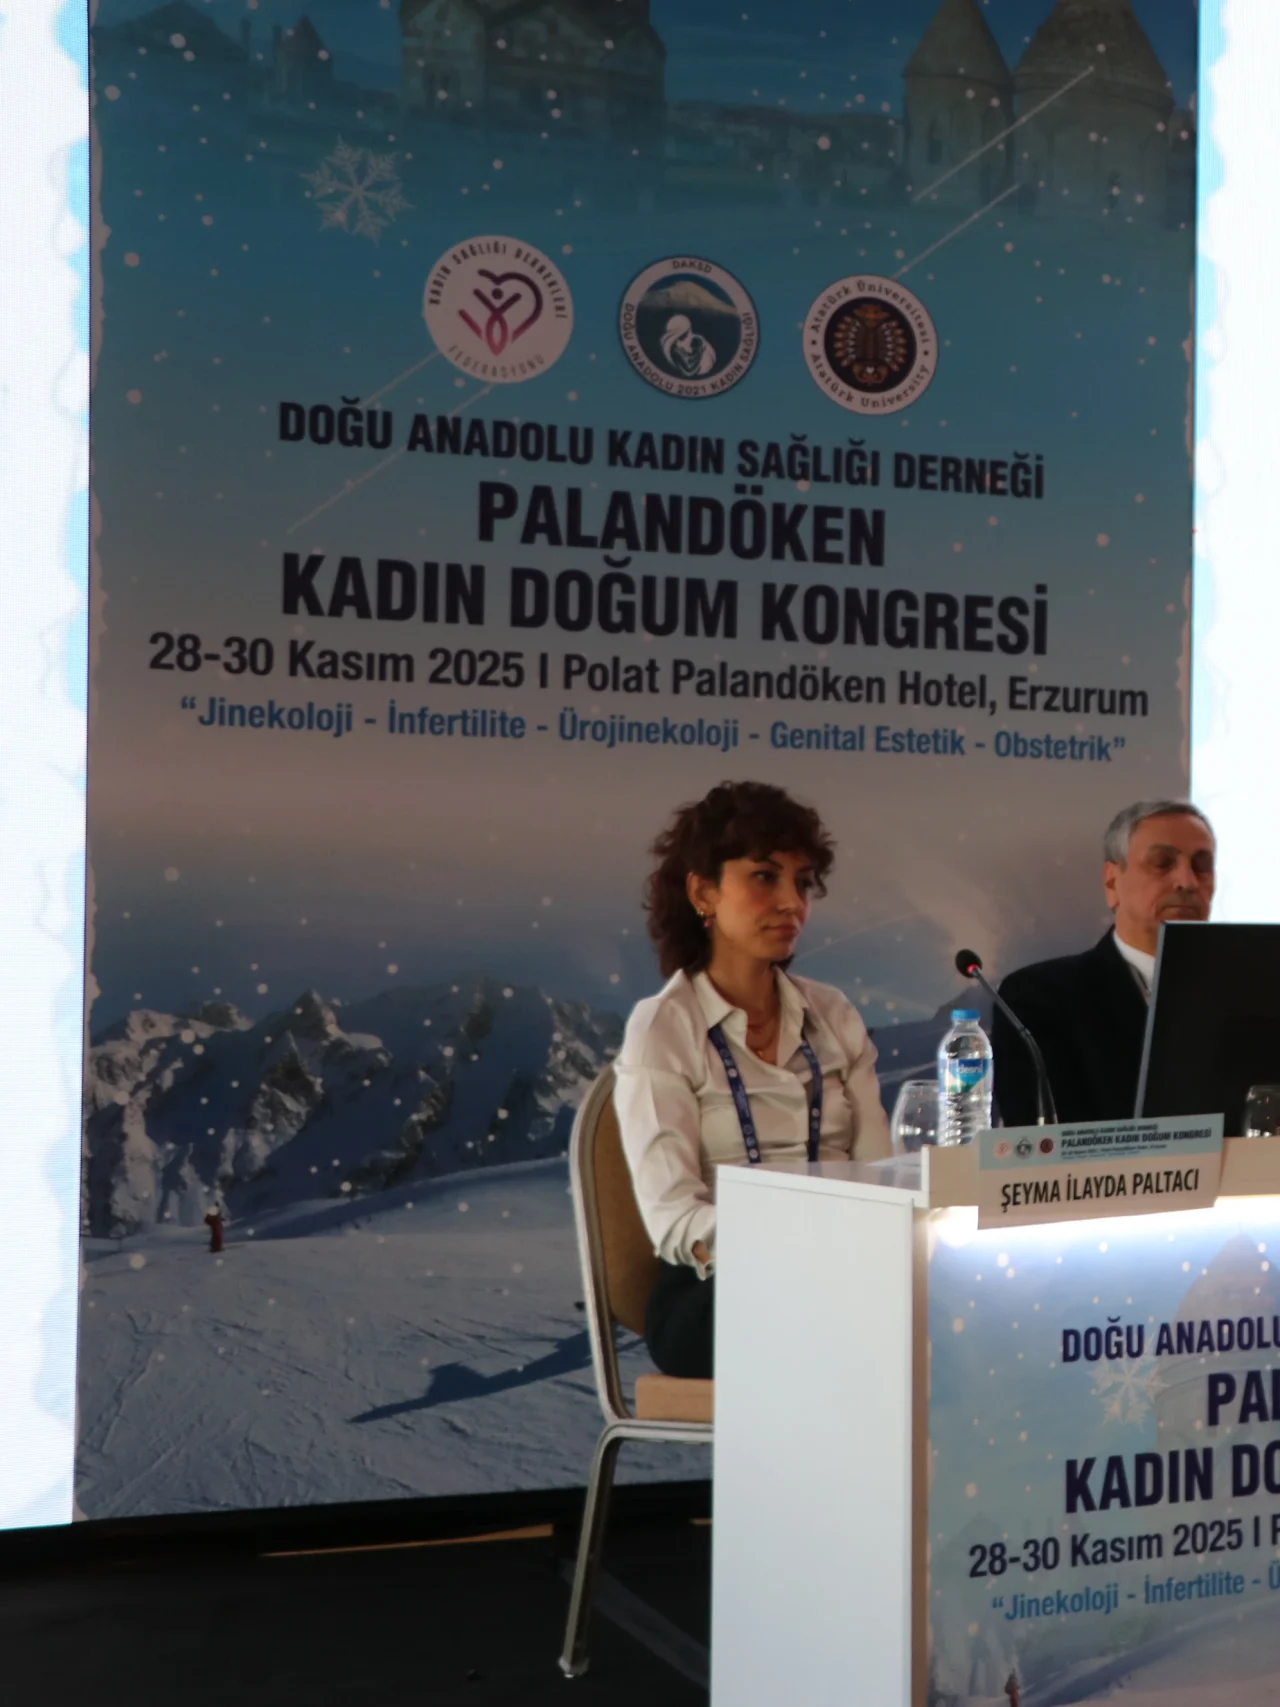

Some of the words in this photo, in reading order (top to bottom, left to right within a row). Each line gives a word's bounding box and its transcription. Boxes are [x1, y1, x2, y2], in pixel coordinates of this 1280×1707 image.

[429, 264, 453, 306] KADIN
[811, 285, 851, 333] Atatürk
[856, 279, 931, 344] Üniversitesi
[622, 302, 636, 341] DOĞU
[741, 312, 755, 363] SAĞLIĞI
[627, 344, 674, 391] ANADOLU
[711, 364, 744, 391] KADIN
[810, 353, 854, 403] Atatürk
[860, 364, 930, 409] University
[279, 396, 392, 450] DOĞU
[407, 413, 595, 465] ANADOLU
[607, 429, 726, 475] KADIN
[737, 433, 880, 487] SAĞLIĞI
[894, 450, 1045, 500] DERNEĞİ
[478, 480, 886, 567] PALANDÖKEN
[281, 552, 485, 626] KADIN
[510, 555, 738, 639] DOĞUM
[761, 582, 1048, 656] KONGRESİ
[149, 631, 274, 677] 28-30
[288, 640, 415, 684] Kasım
[428, 647, 524, 689] 2025
[563, 655, 660, 694] Polat
[671, 658, 886, 705] Palandöken
[898, 669, 998, 716] Hotel,
[1008, 675, 1149, 717] Erzurum
[181, 696, 353, 739] “Jinekoloji
[388, 699, 526, 739] İnfertilite
[558, 707, 739, 753] Ürojinekoloji
[770, 721, 865, 753] Genital
[875, 725, 965, 756] Estetik
[994, 729, 1126, 762] Obstetrik”
[1061, 1132, 1114, 1148] PALANDÖKEN
[1001, 1180, 1061, 1213] ŞEYMA
[1066, 1173, 1128, 1201] İLAYDA
[1132, 1168, 1199, 1195] PALTACI
[1062, 1315, 1145, 1363] DOĞU
[1065, 1446, 1214, 1514] KADIN
[969, 1536, 1060, 1578] 28-30
[1071, 1531, 1164, 1568] Kasım
[1173, 1518, 1244, 1556] 2025
[1144, 1571, 1245, 1605] İnfertilite
